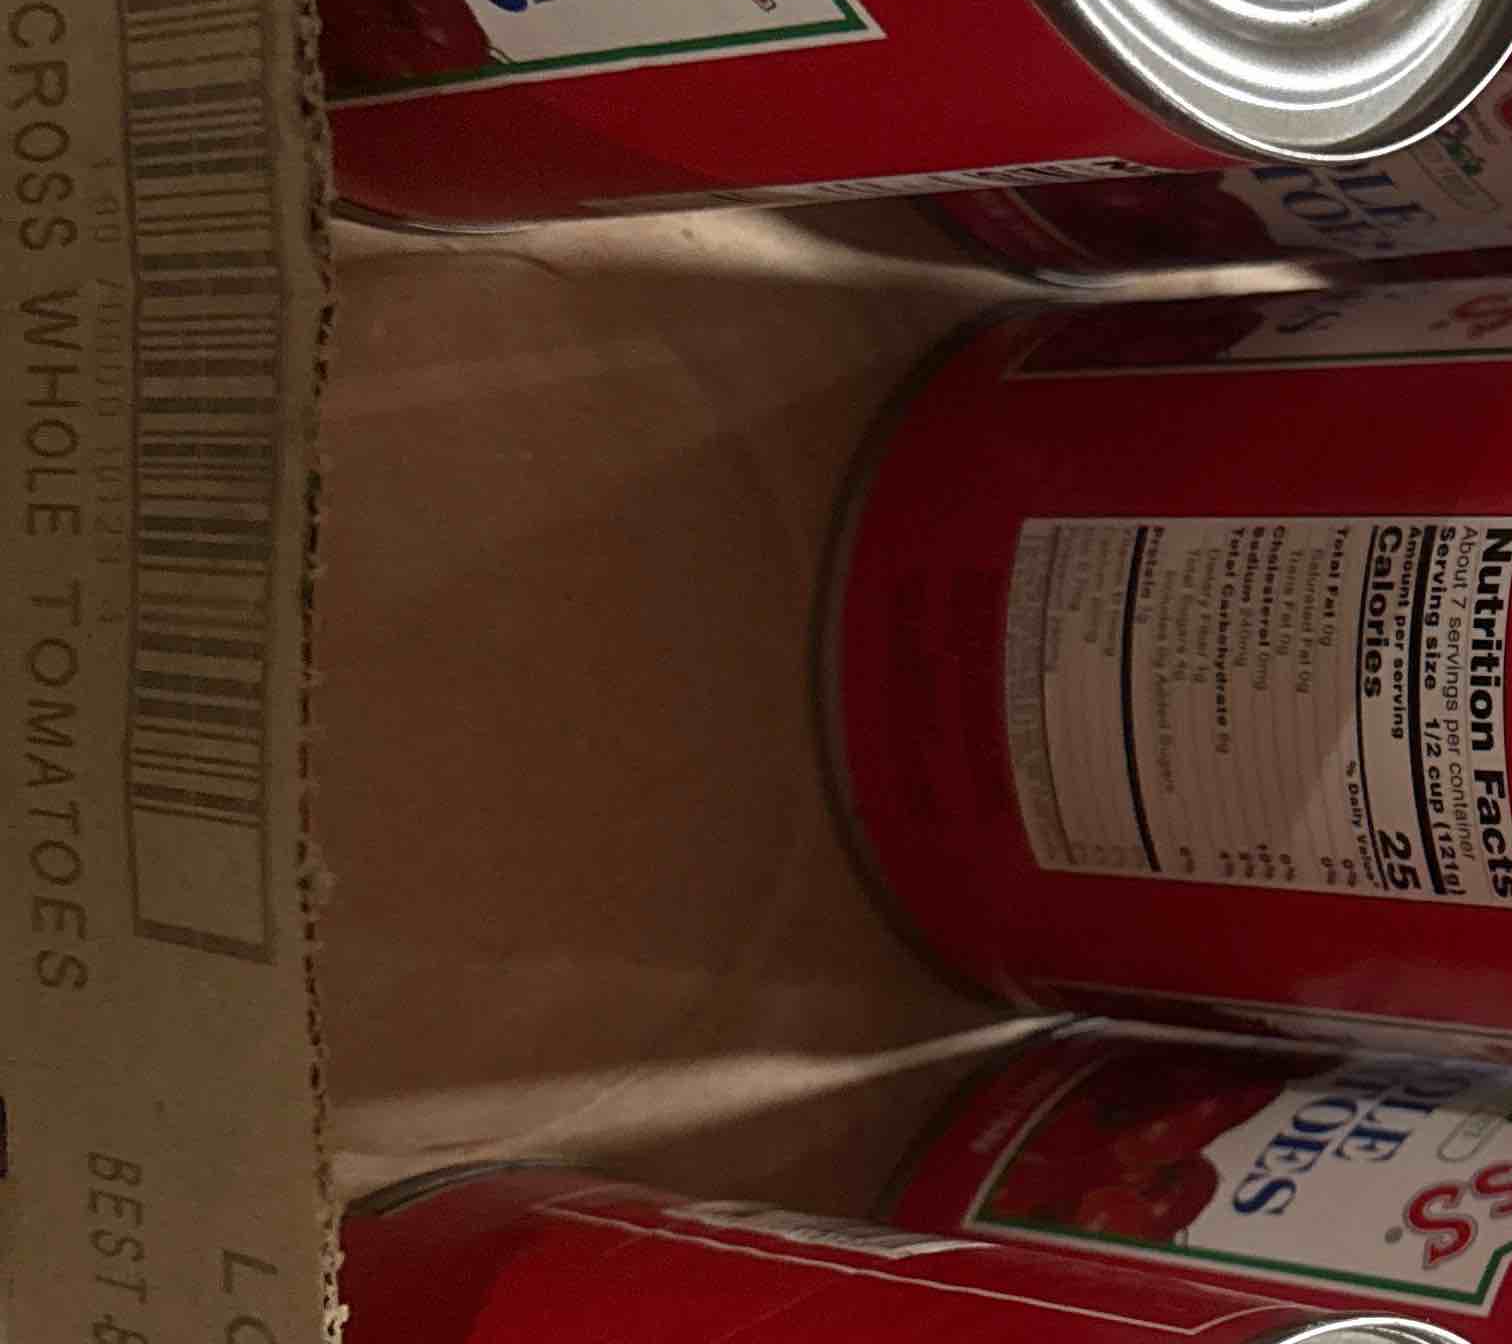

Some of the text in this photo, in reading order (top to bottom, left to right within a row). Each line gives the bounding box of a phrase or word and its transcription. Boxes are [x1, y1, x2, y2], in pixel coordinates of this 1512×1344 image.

[9, 1, 78, 253] CROSS
[20, 287, 84, 536] WHOLE
[1223, 527, 1244, 578] Total
[1240, 527, 1265, 603] Sodium
[1258, 527, 1285, 647] Cholesterol
[1322, 585, 1338, 619] Fat
[1327, 528, 1349, 579] Total
[1214, 584, 1236, 727] Carbohydrate
[1320, 624, 1335, 647] 0g
[1390, 525, 1422, 740] Amount per serving
[1442, 526, 1478, 862] About 7 servings per container
[1363, 525, 1421, 892] Calories 25
[1424, 527, 1465, 897] Serving size 1/2 cup (121g)
[25, 579, 89, 991] TOMATOES
[1346, 783, 1365, 829] Daily
[86, 1151, 149, 1304] BEST
